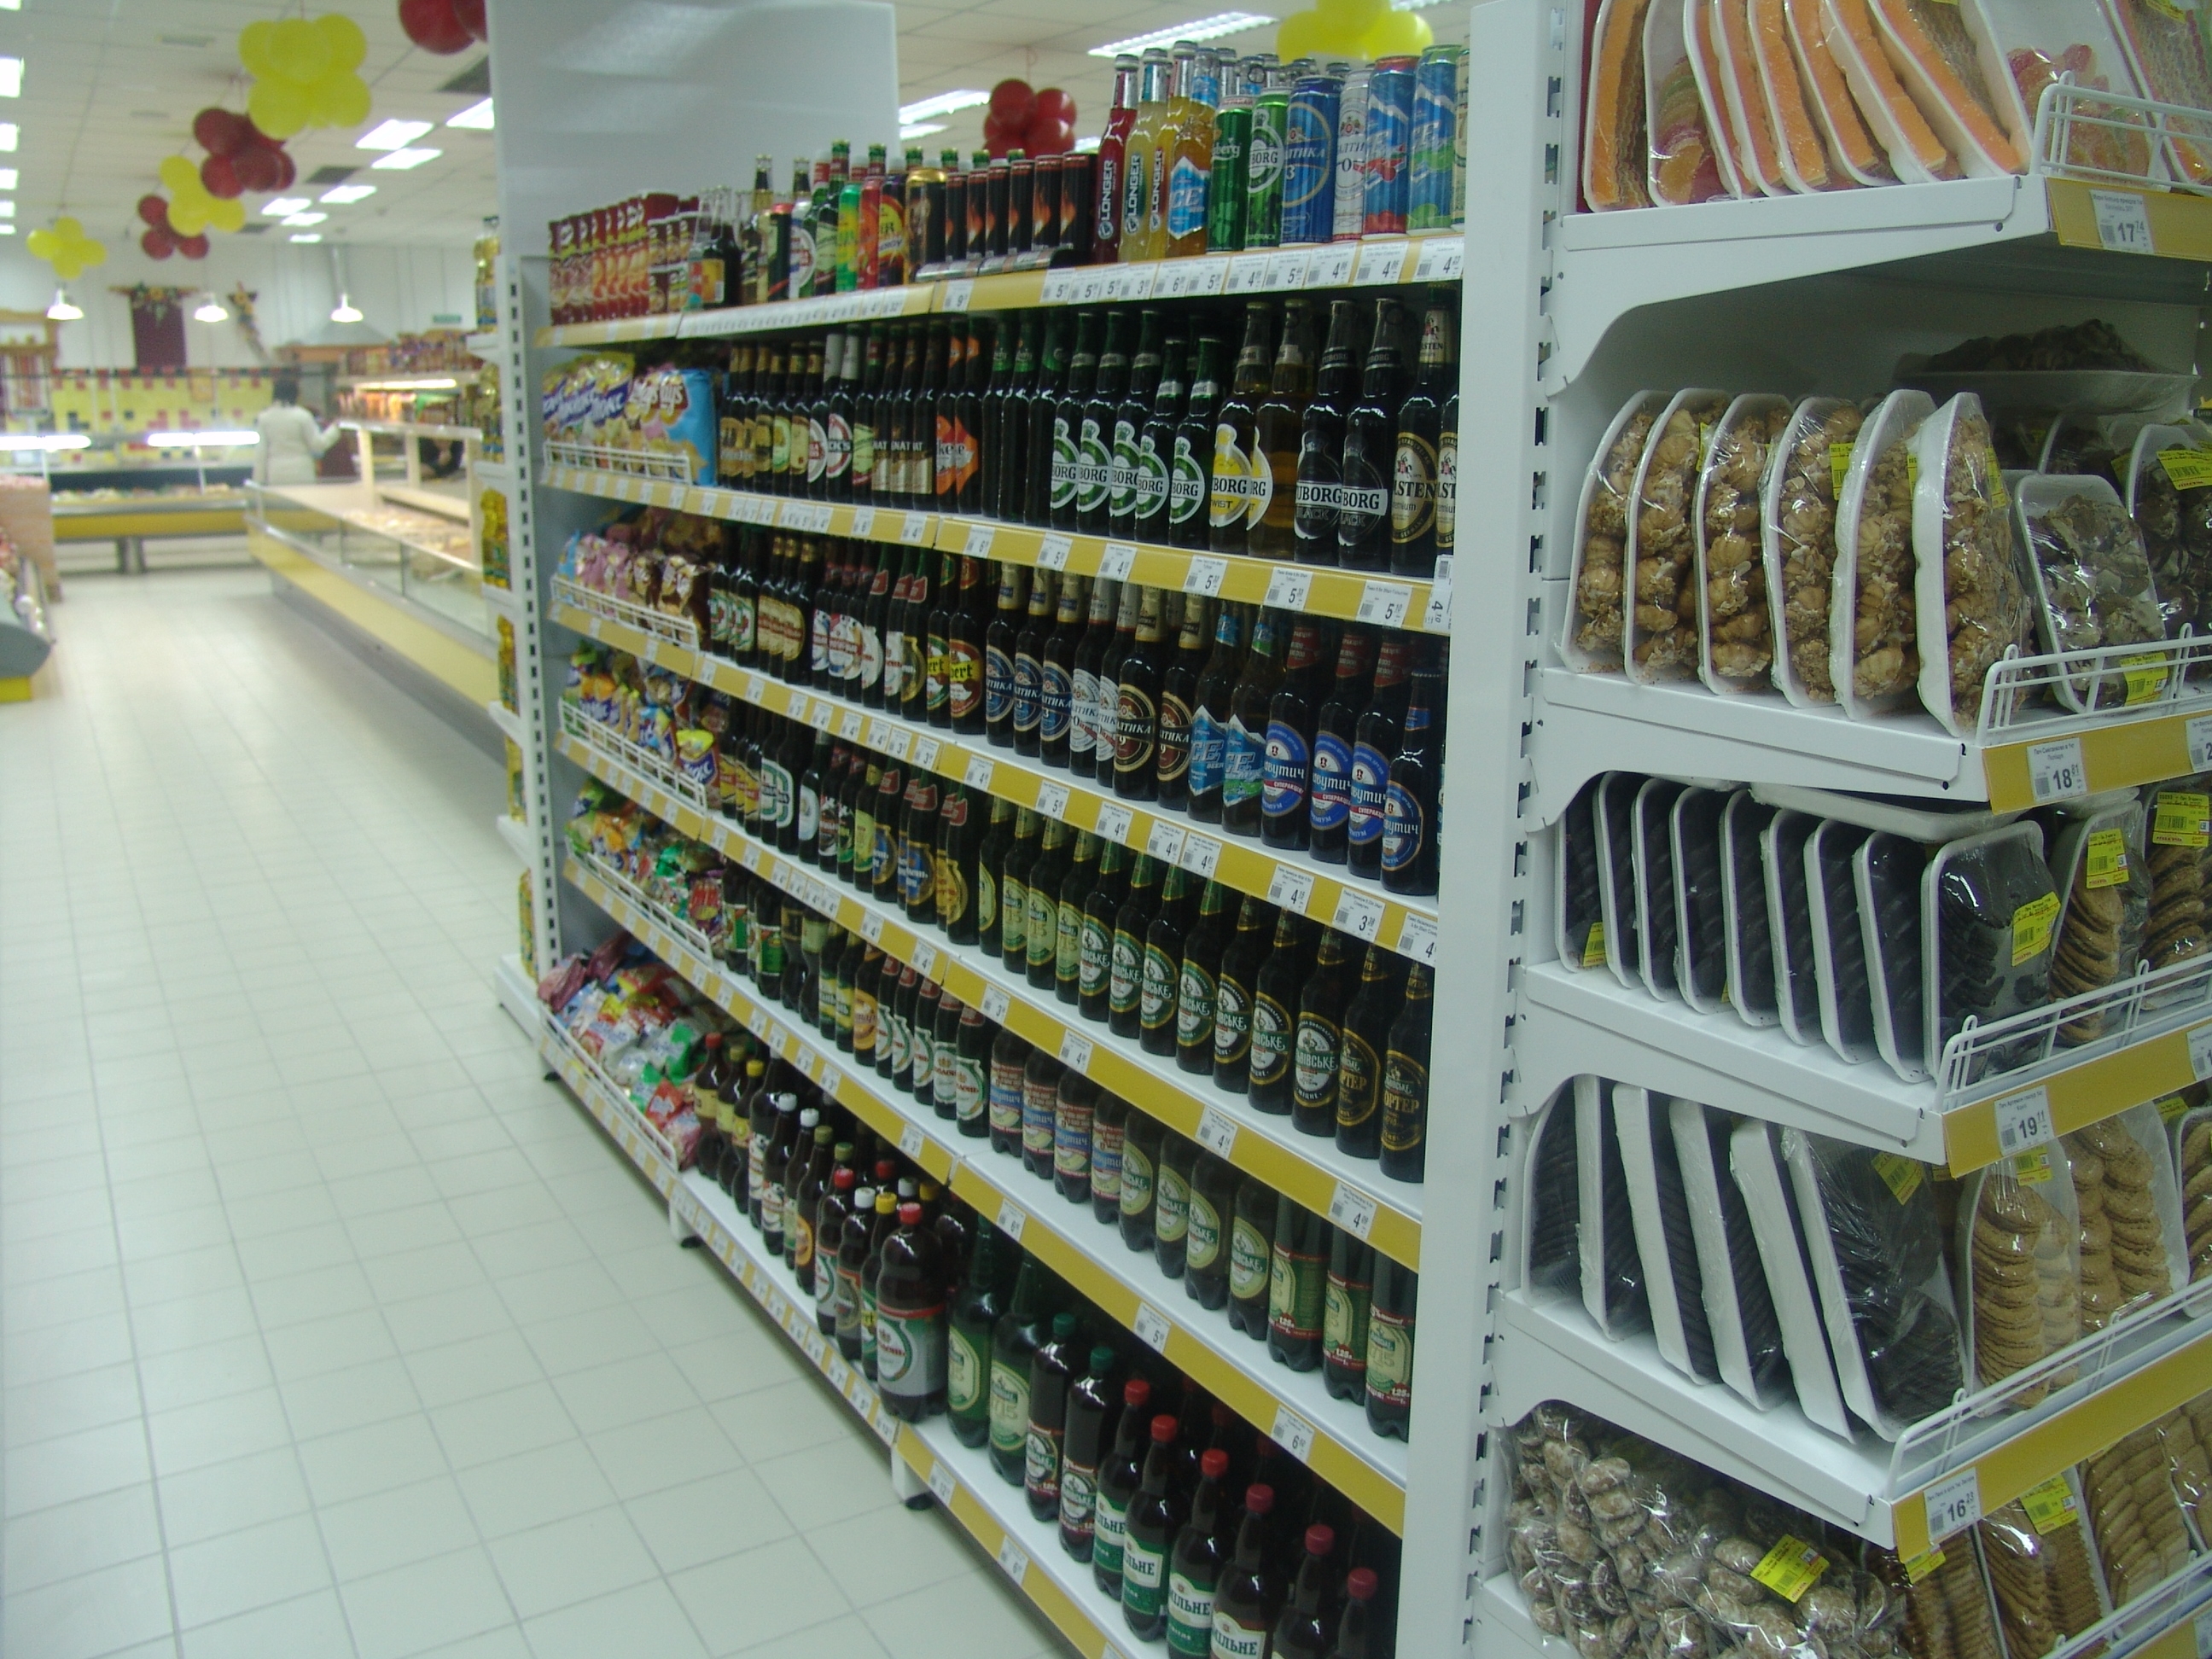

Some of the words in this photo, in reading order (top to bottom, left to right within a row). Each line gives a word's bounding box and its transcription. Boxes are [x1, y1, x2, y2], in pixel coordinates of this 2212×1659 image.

[1250, 150, 1278, 165] BORG
[1128, 154, 1140, 216] LONGER
[1152, 150, 1162, 213] LONGER
[1101, 160, 1113, 221] LONGER
[2117, 222, 2134, 242] 17
[1332, 262, 1340, 278] 4
[1382, 261, 1391, 277] 4
[1442, 257, 1452, 273] 4
[1208, 275, 1215, 289] 5
[1248, 271, 1255, 287] 4
[1288, 268, 1295, 283] 5
[1138, 280, 1144, 294] 3
[1173, 278, 1179, 291] 6
[1052, 465, 1076, 480] BORG
[1080, 468, 1107, 482] BORG
[1138, 479, 1163, 493] BORG
[1172, 481, 1198, 496] BORG
[1213, 477, 1248, 494] BORG
[1394, 480, 1437, 498] LSTEN
[1297, 485, 1341, 504] UBORG
[1343, 493, 1380, 509] BORG
[1053, 552, 1060, 565] 5
[1117, 562, 1124, 575] 4
[1205, 575, 1213, 590] 5
[1289, 588, 1297, 603] 5
[1385, 603, 1394, 620] 5
[1431, 601, 1444, 611] 4
[1044, 708, 1050, 719] 3
[1119, 735, 1126, 745] 9
[1161, 743, 1167, 754] 9
[1191, 739, 1225, 762] CE
[2052, 768, 2073, 790] 18
[1052, 800, 1059, 812] 5
[1115, 823, 1121, 836] 4
[1166, 842, 1173, 857] 4
[1201, 855, 1208, 870] 4
[1290, 888, 1298, 905] 4
[1359, 915, 1367, 932] 3
[1425, 941, 1435, 958] 4
[1076, 1051, 1082, 1065] 4
[1384, 1090, 1420, 1114] ОРТЕР
[2019, 1116, 2038, 1138] 19
[1218, 1134, 1225, 1149] 4
[1353, 1213, 1361, 1228] 4
[1152, 1330, 1159, 1342] 5
[1291, 1435, 1299, 1450] 6
[1947, 1499, 1966, 1522] 16
